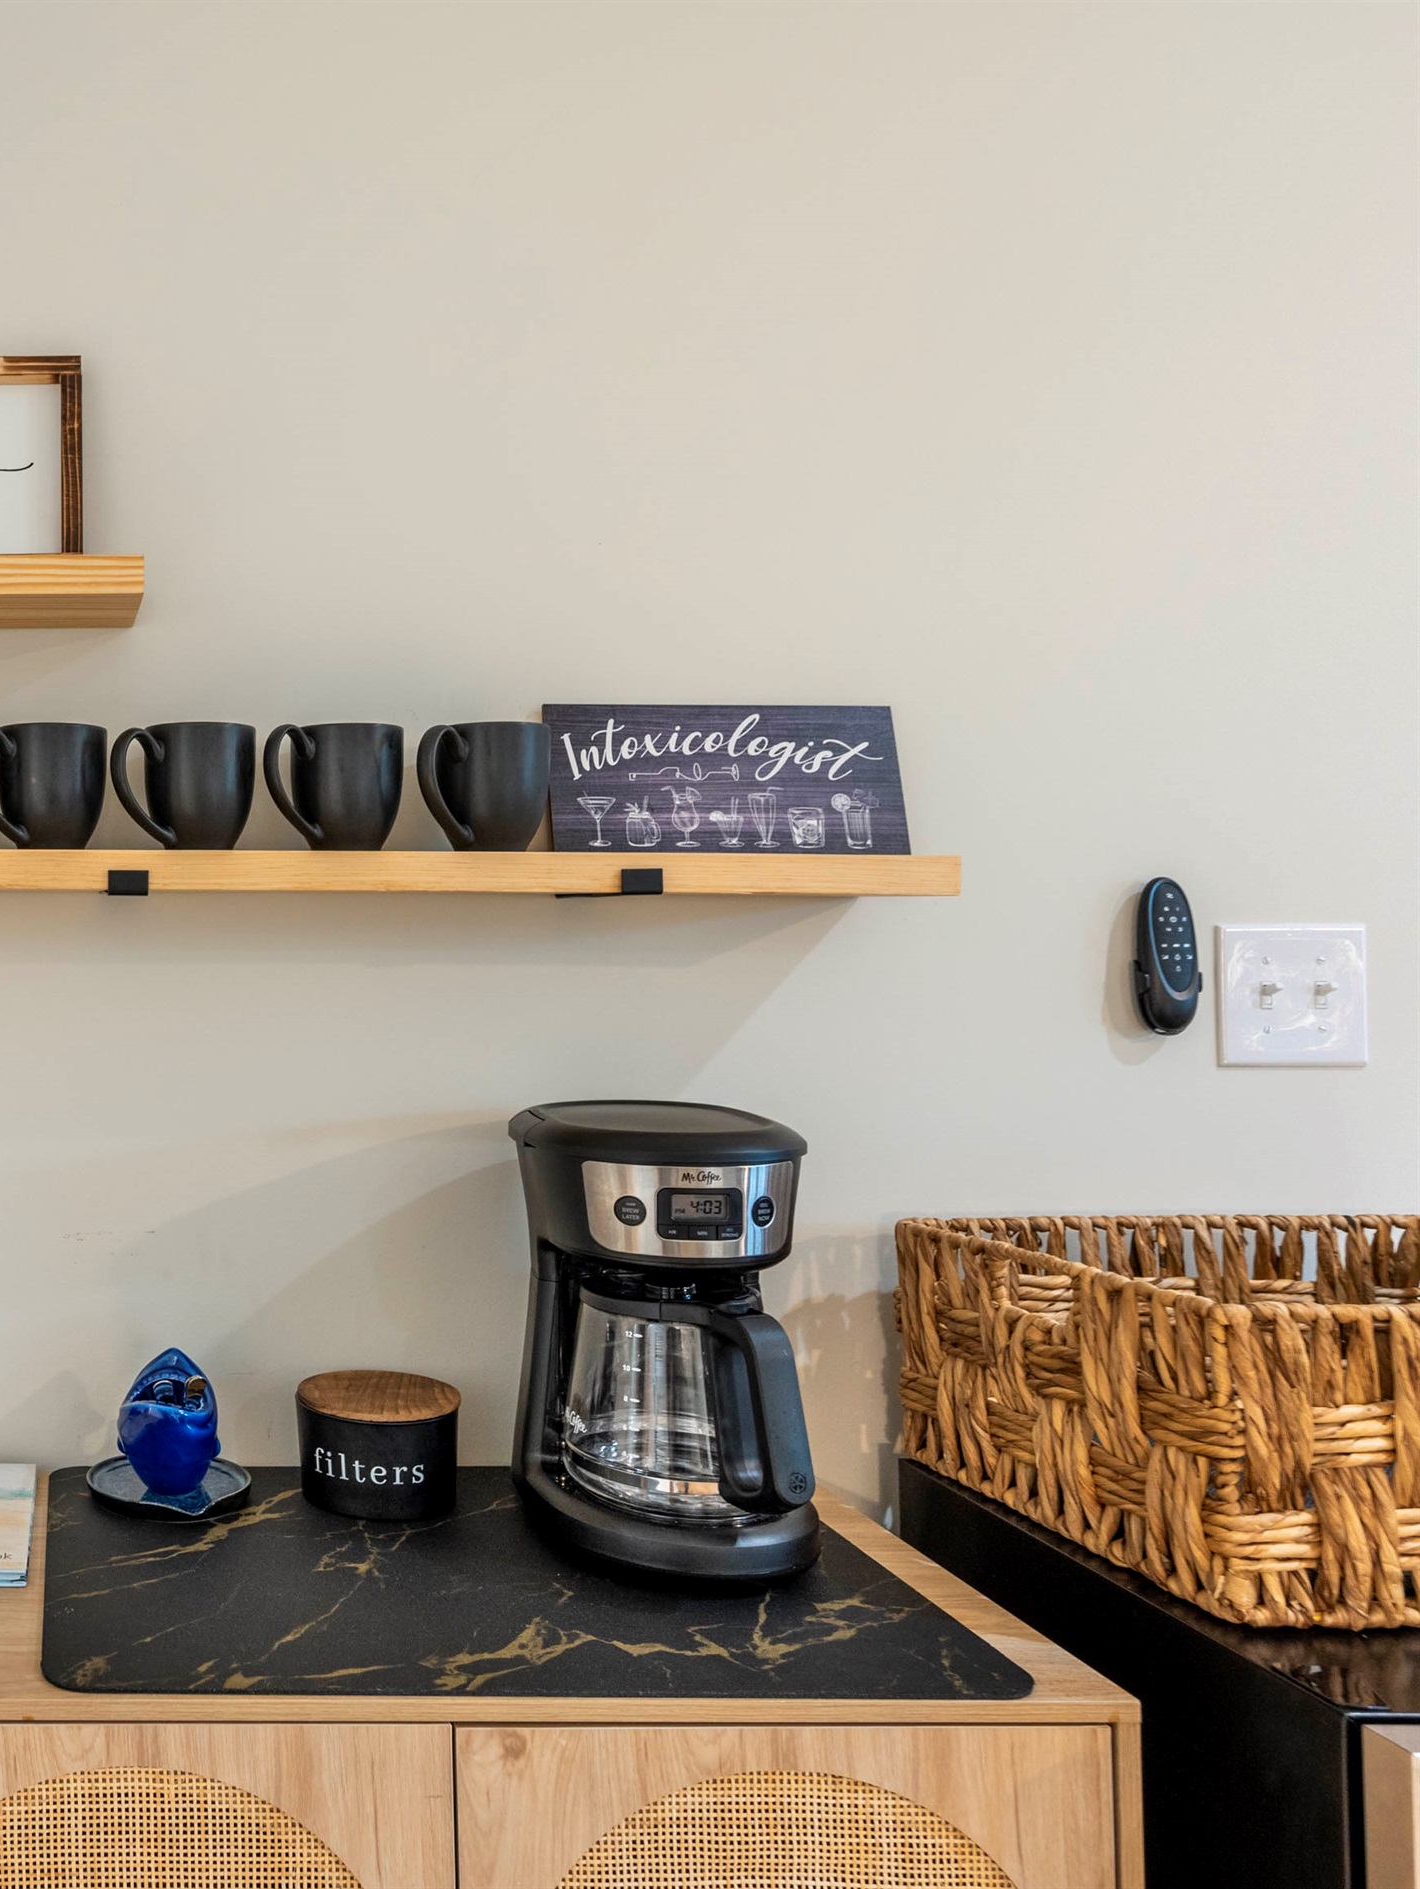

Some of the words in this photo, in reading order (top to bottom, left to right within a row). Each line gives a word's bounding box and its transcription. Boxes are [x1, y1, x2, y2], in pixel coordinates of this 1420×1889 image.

[560, 713, 884, 782] Intoxicologist
[696, 1170, 721, 1186] Coffee
[621, 1206, 640, 1214] BREW
[689, 1200, 722, 1215] 4:03
[621, 1213, 640, 1221] LATER
[625, 1330, 633, 1338] 12
[313, 1447, 425, 1485] filters
